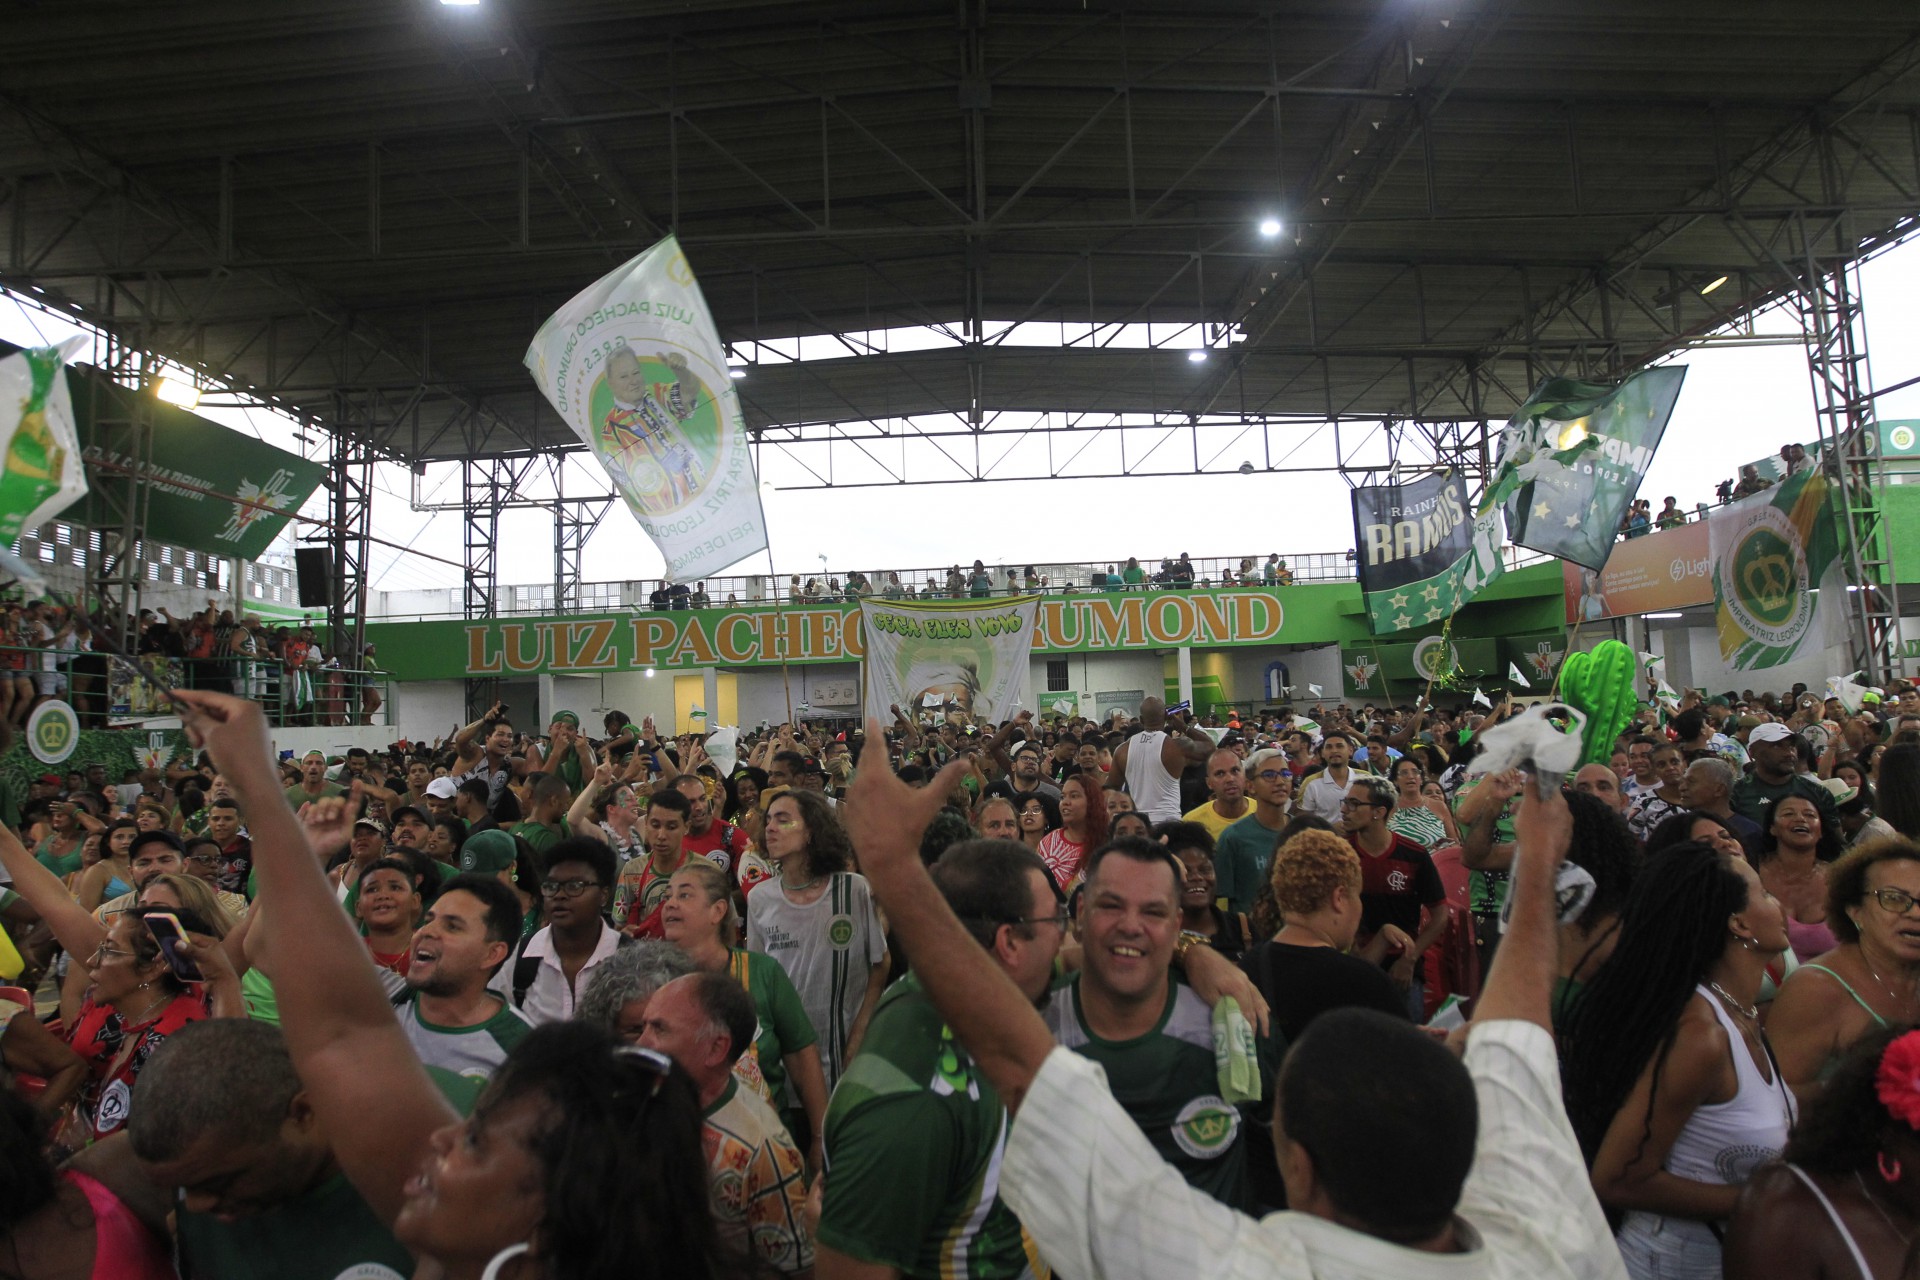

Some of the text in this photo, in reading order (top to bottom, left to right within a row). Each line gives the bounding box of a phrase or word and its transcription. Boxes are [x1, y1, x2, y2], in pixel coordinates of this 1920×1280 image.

[1365, 484, 1465, 567] RAMOS
[1391, 494, 1440, 517] RAINH
[466, 618, 617, 673] LUIZ
[629, 608, 864, 667] PACHEC
[922, 618, 972, 640] ELES
[1727, 598, 1775, 642] IMPERATRIZ
